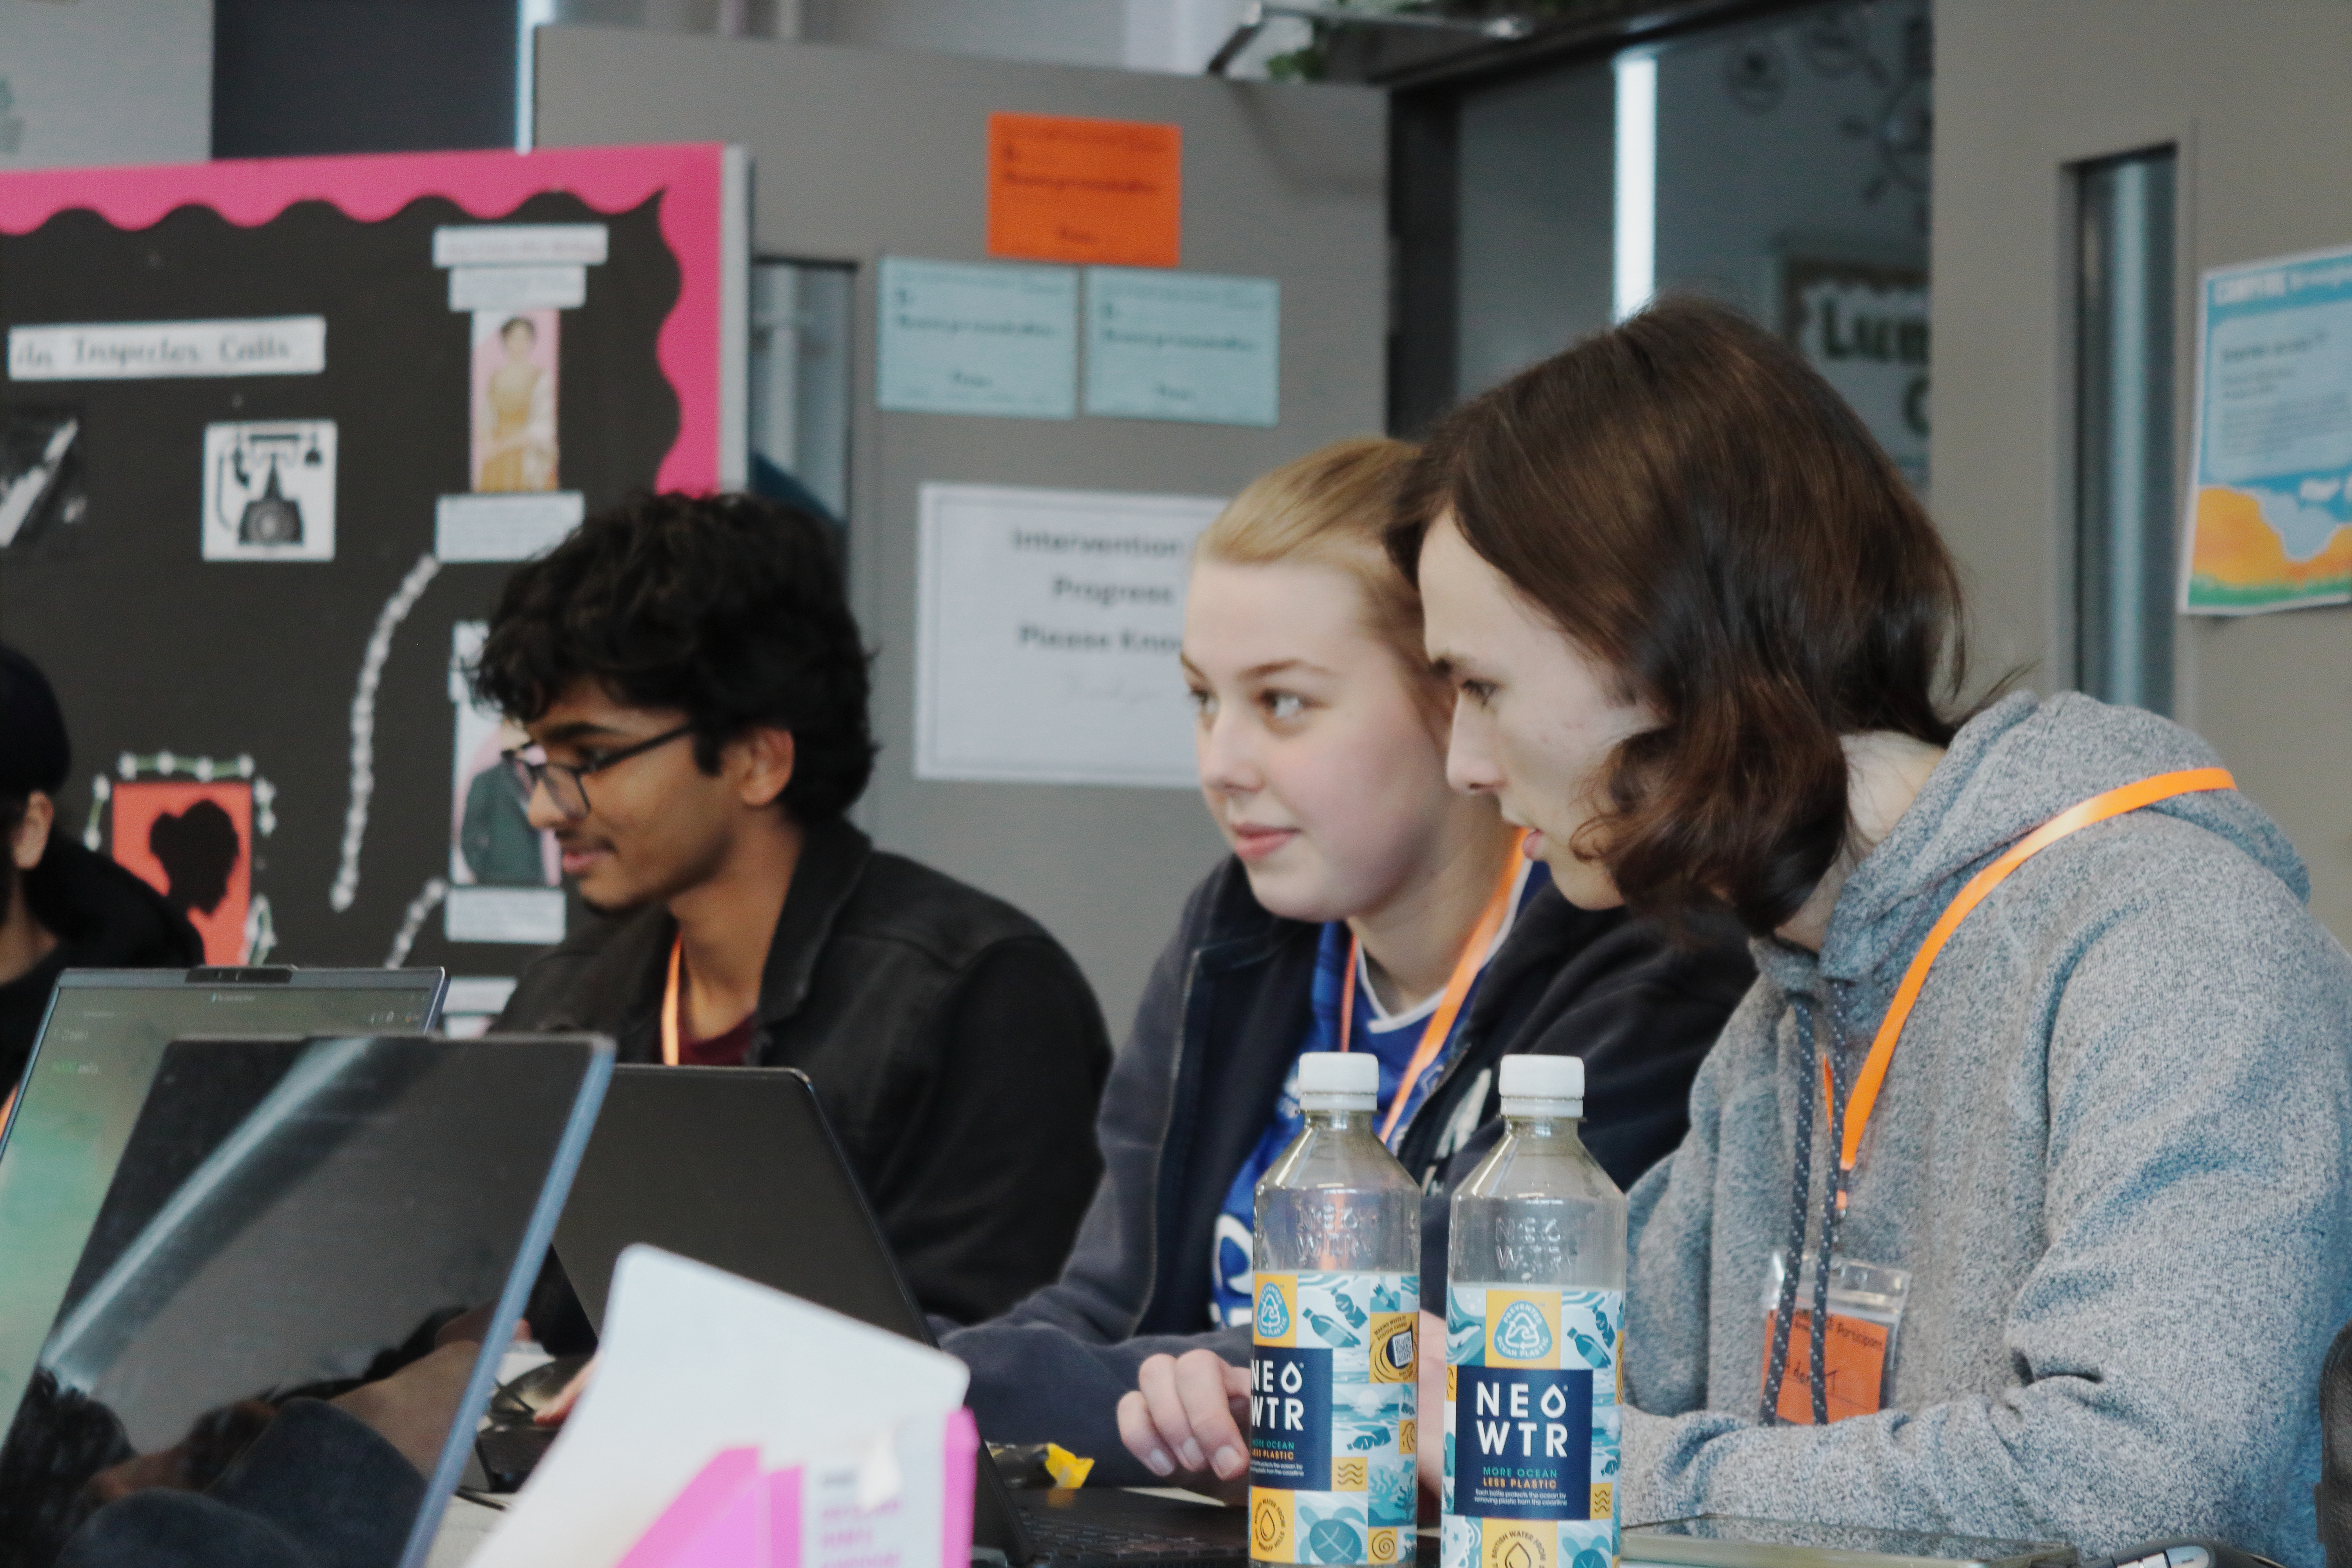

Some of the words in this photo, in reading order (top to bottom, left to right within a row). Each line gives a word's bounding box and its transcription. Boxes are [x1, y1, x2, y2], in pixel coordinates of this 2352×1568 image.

[1251, 1395, 1304, 1431] WTR
[1477, 1419, 1568, 1457] WTR
[1267, 1440, 1294, 1450] OCEAN
[1263, 1450, 1294, 1460] PLASTIC
[1483, 1466, 1512, 1477] MORE
[1517, 1468, 1557, 1478] OCEAN
[1483, 1477, 1506, 1488] LESS
[1510, 1478, 1557, 1489] PLASTIC
